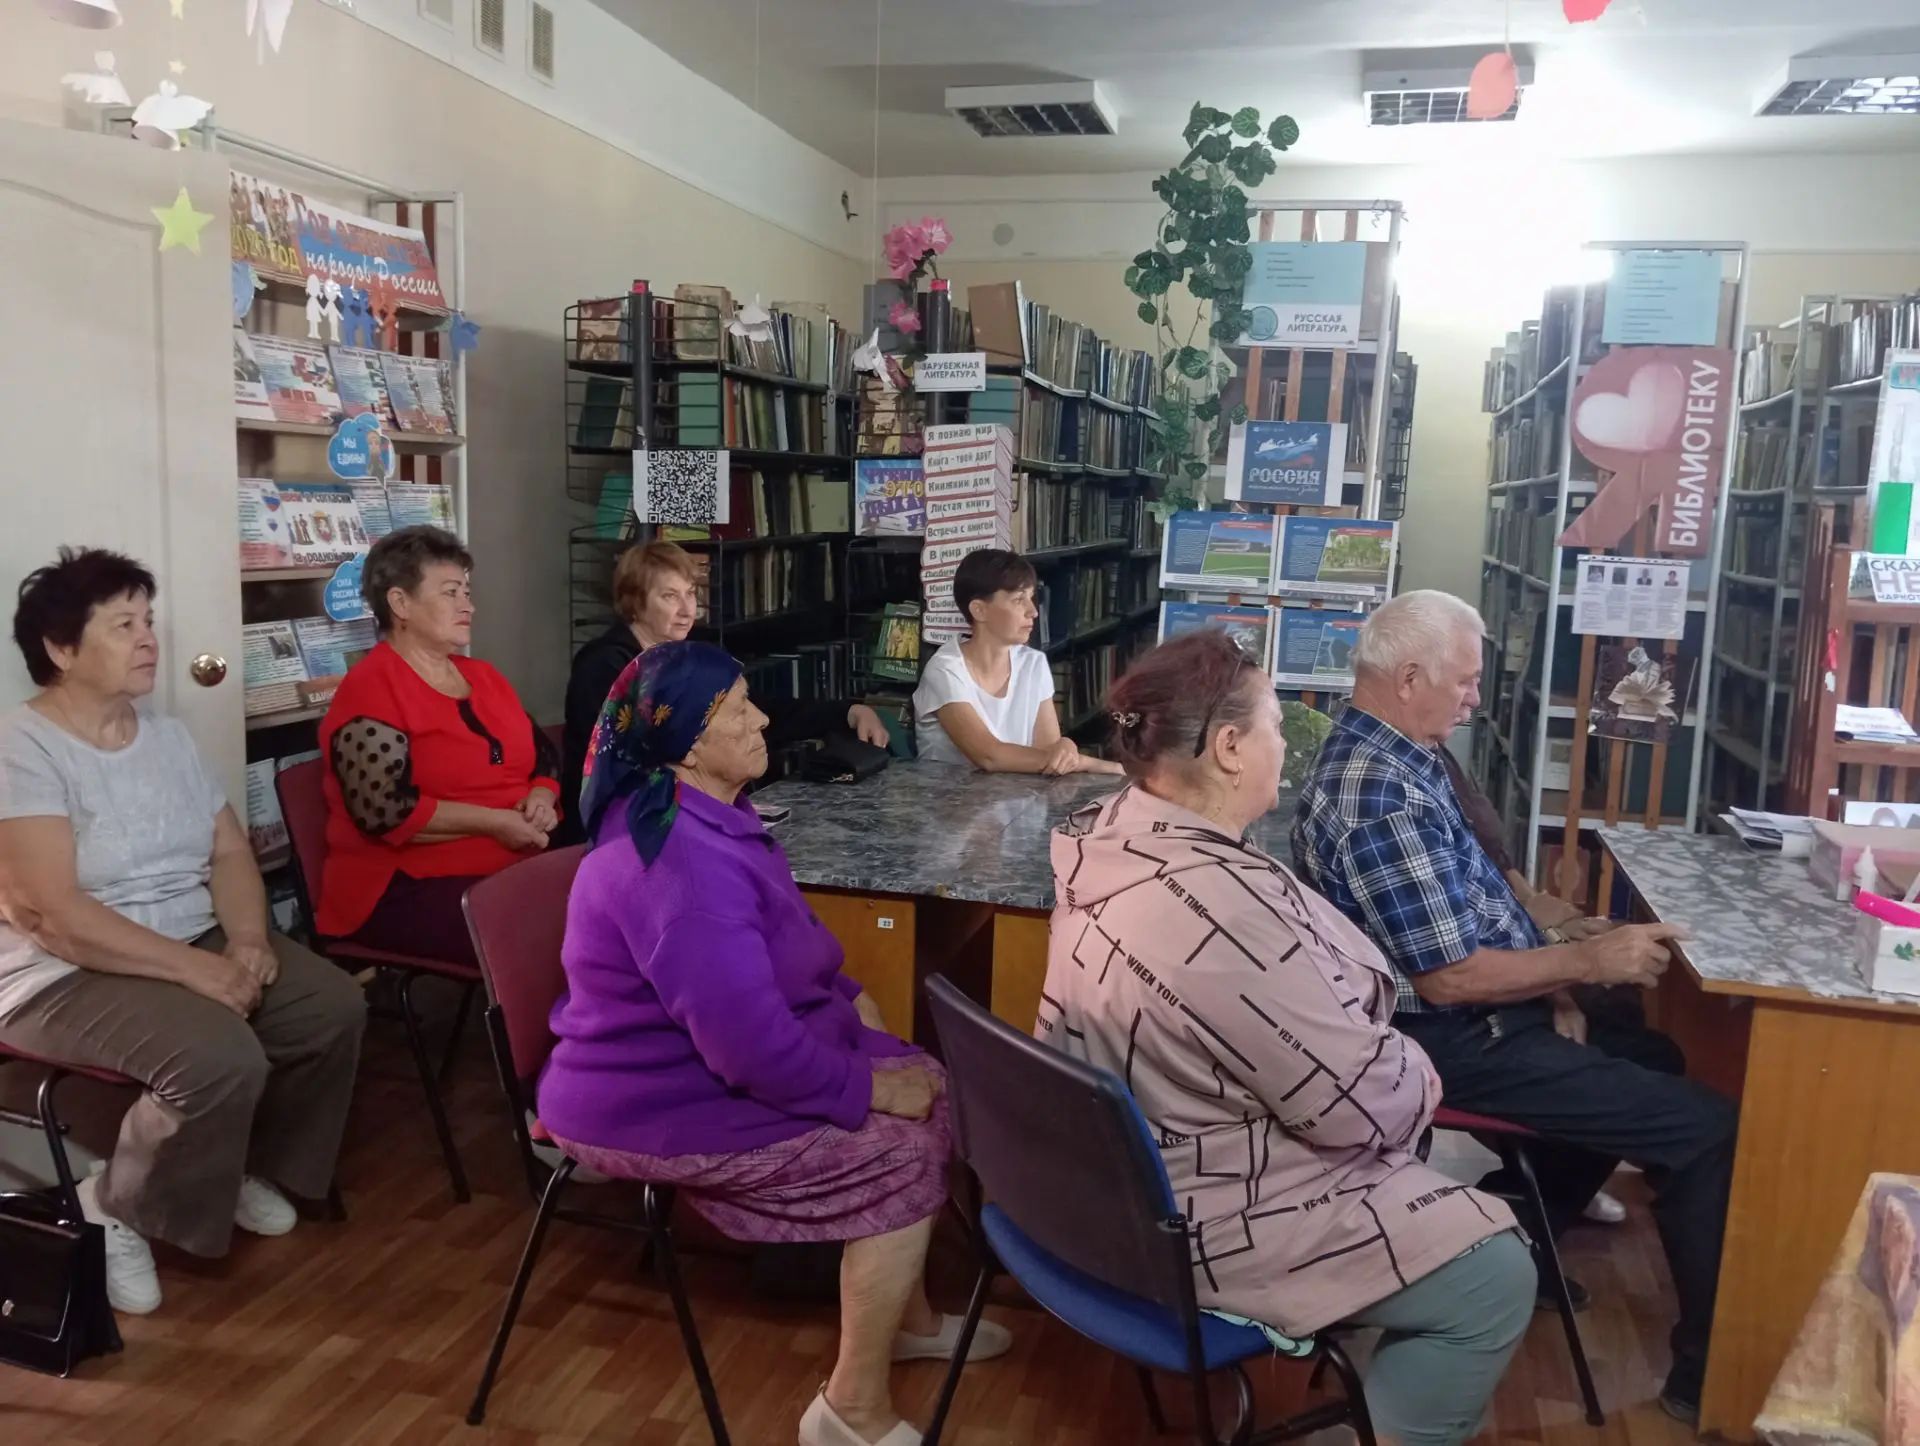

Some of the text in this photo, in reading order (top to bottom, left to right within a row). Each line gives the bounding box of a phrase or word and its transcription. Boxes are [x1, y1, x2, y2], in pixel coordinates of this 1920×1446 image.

[373, 256, 441, 297] России
[1294, 314, 1342, 323] РУССКАЯ
[1286, 323, 1348, 333] ЛИТЕРАТУРА
[921, 361, 980, 370] ЗАРУБЕЖНАЯ
[924, 370, 977, 379] ЛИТЕРАТУРА
[928, 425, 992, 441] Я познаю мир
[976, 450, 992, 461] друг
[1668, 359, 1721, 547] БИБЛИОТЕКУ
[973, 477, 990, 488] дом
[1248, 467, 1321, 485] РОССИЯ
[931, 502, 962, 513] Листая
[966, 499, 990, 509] книгу
[927, 526, 958, 537] Встреча
[967, 520, 994, 532] книгой
[929, 550, 937, 560] В
[942, 548, 961, 558] мир
[1152, 821, 1169, 833] DS
[1164, 877, 1186, 898] THIS
[1184, 894, 1209, 918] TIME
[1127, 954, 1179, 1007] WHEN YOU
[1290, 1039, 1303, 1052] IN
[1405, 1200, 1419, 1214] IN
[1415, 1192, 1437, 1207] THIS
